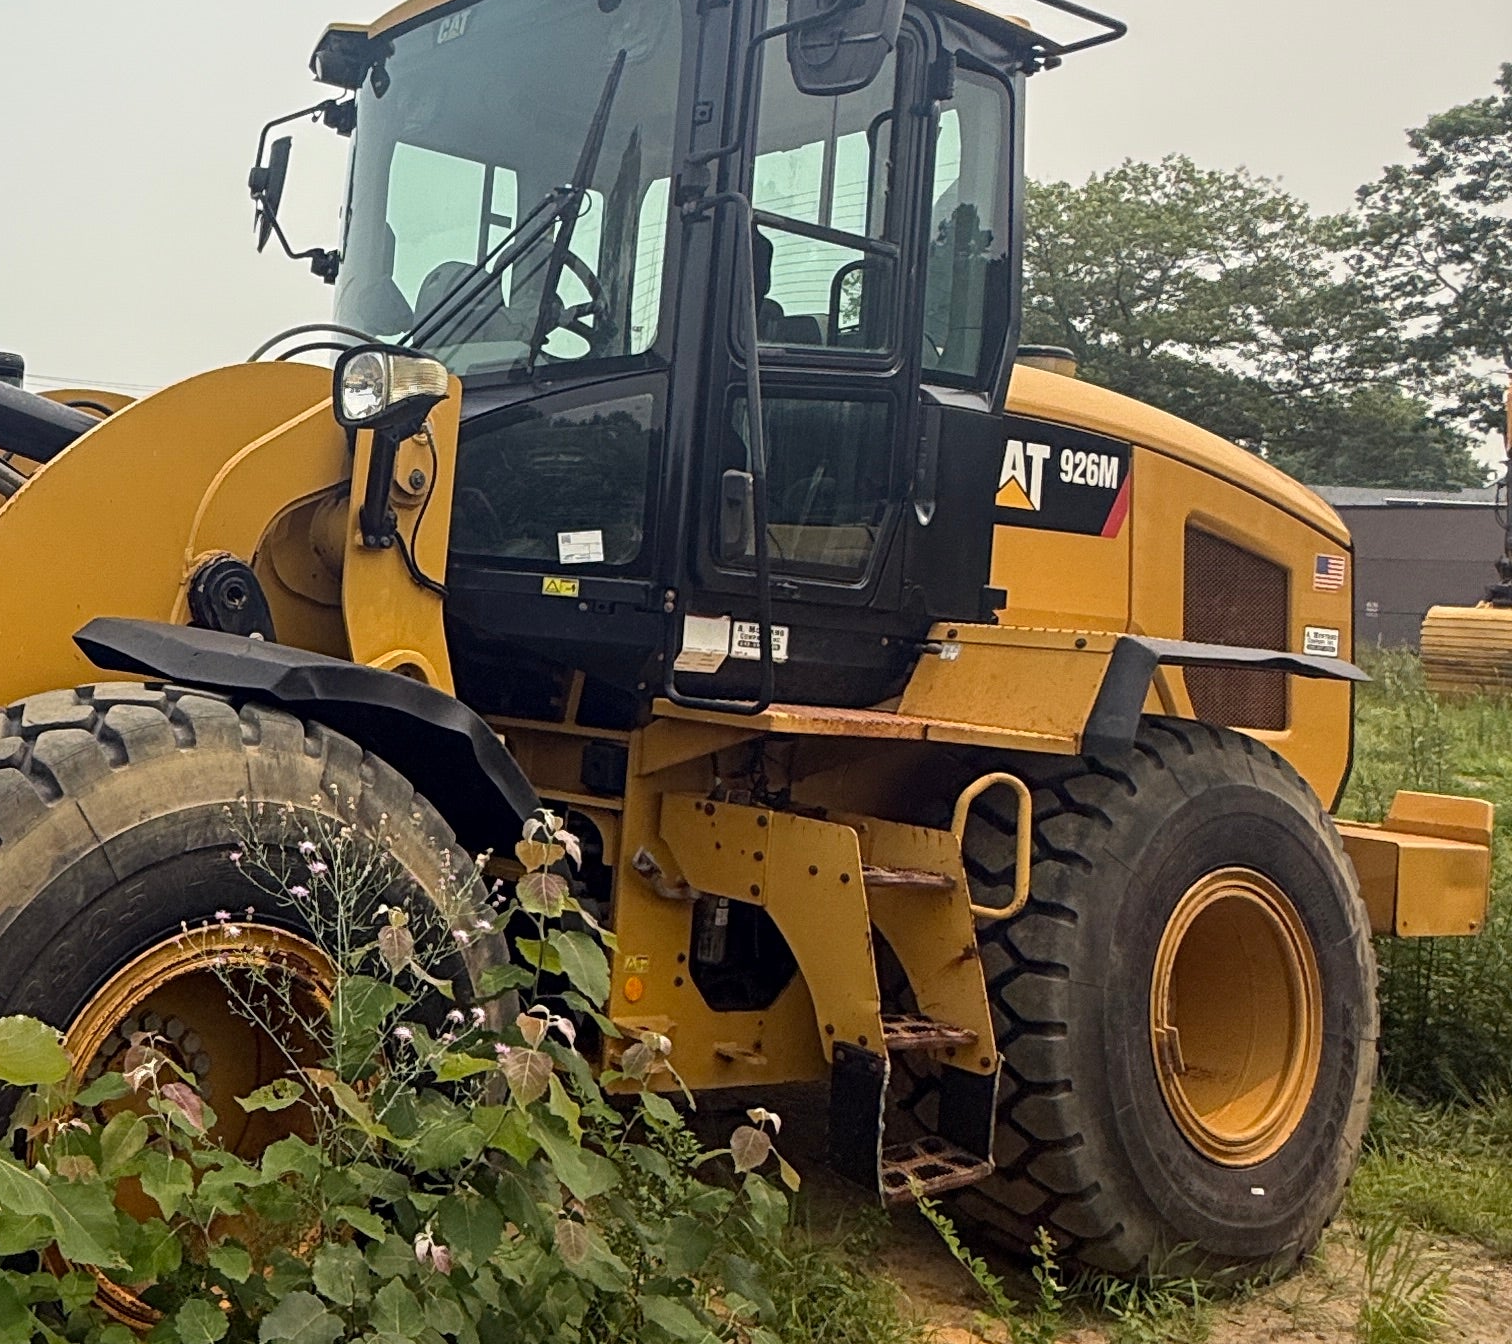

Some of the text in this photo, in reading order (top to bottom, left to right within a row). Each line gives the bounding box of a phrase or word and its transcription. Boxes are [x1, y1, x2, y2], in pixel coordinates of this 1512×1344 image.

[437, 9, 472, 44] CAT
[998, 439, 1120, 511] AT 926M
